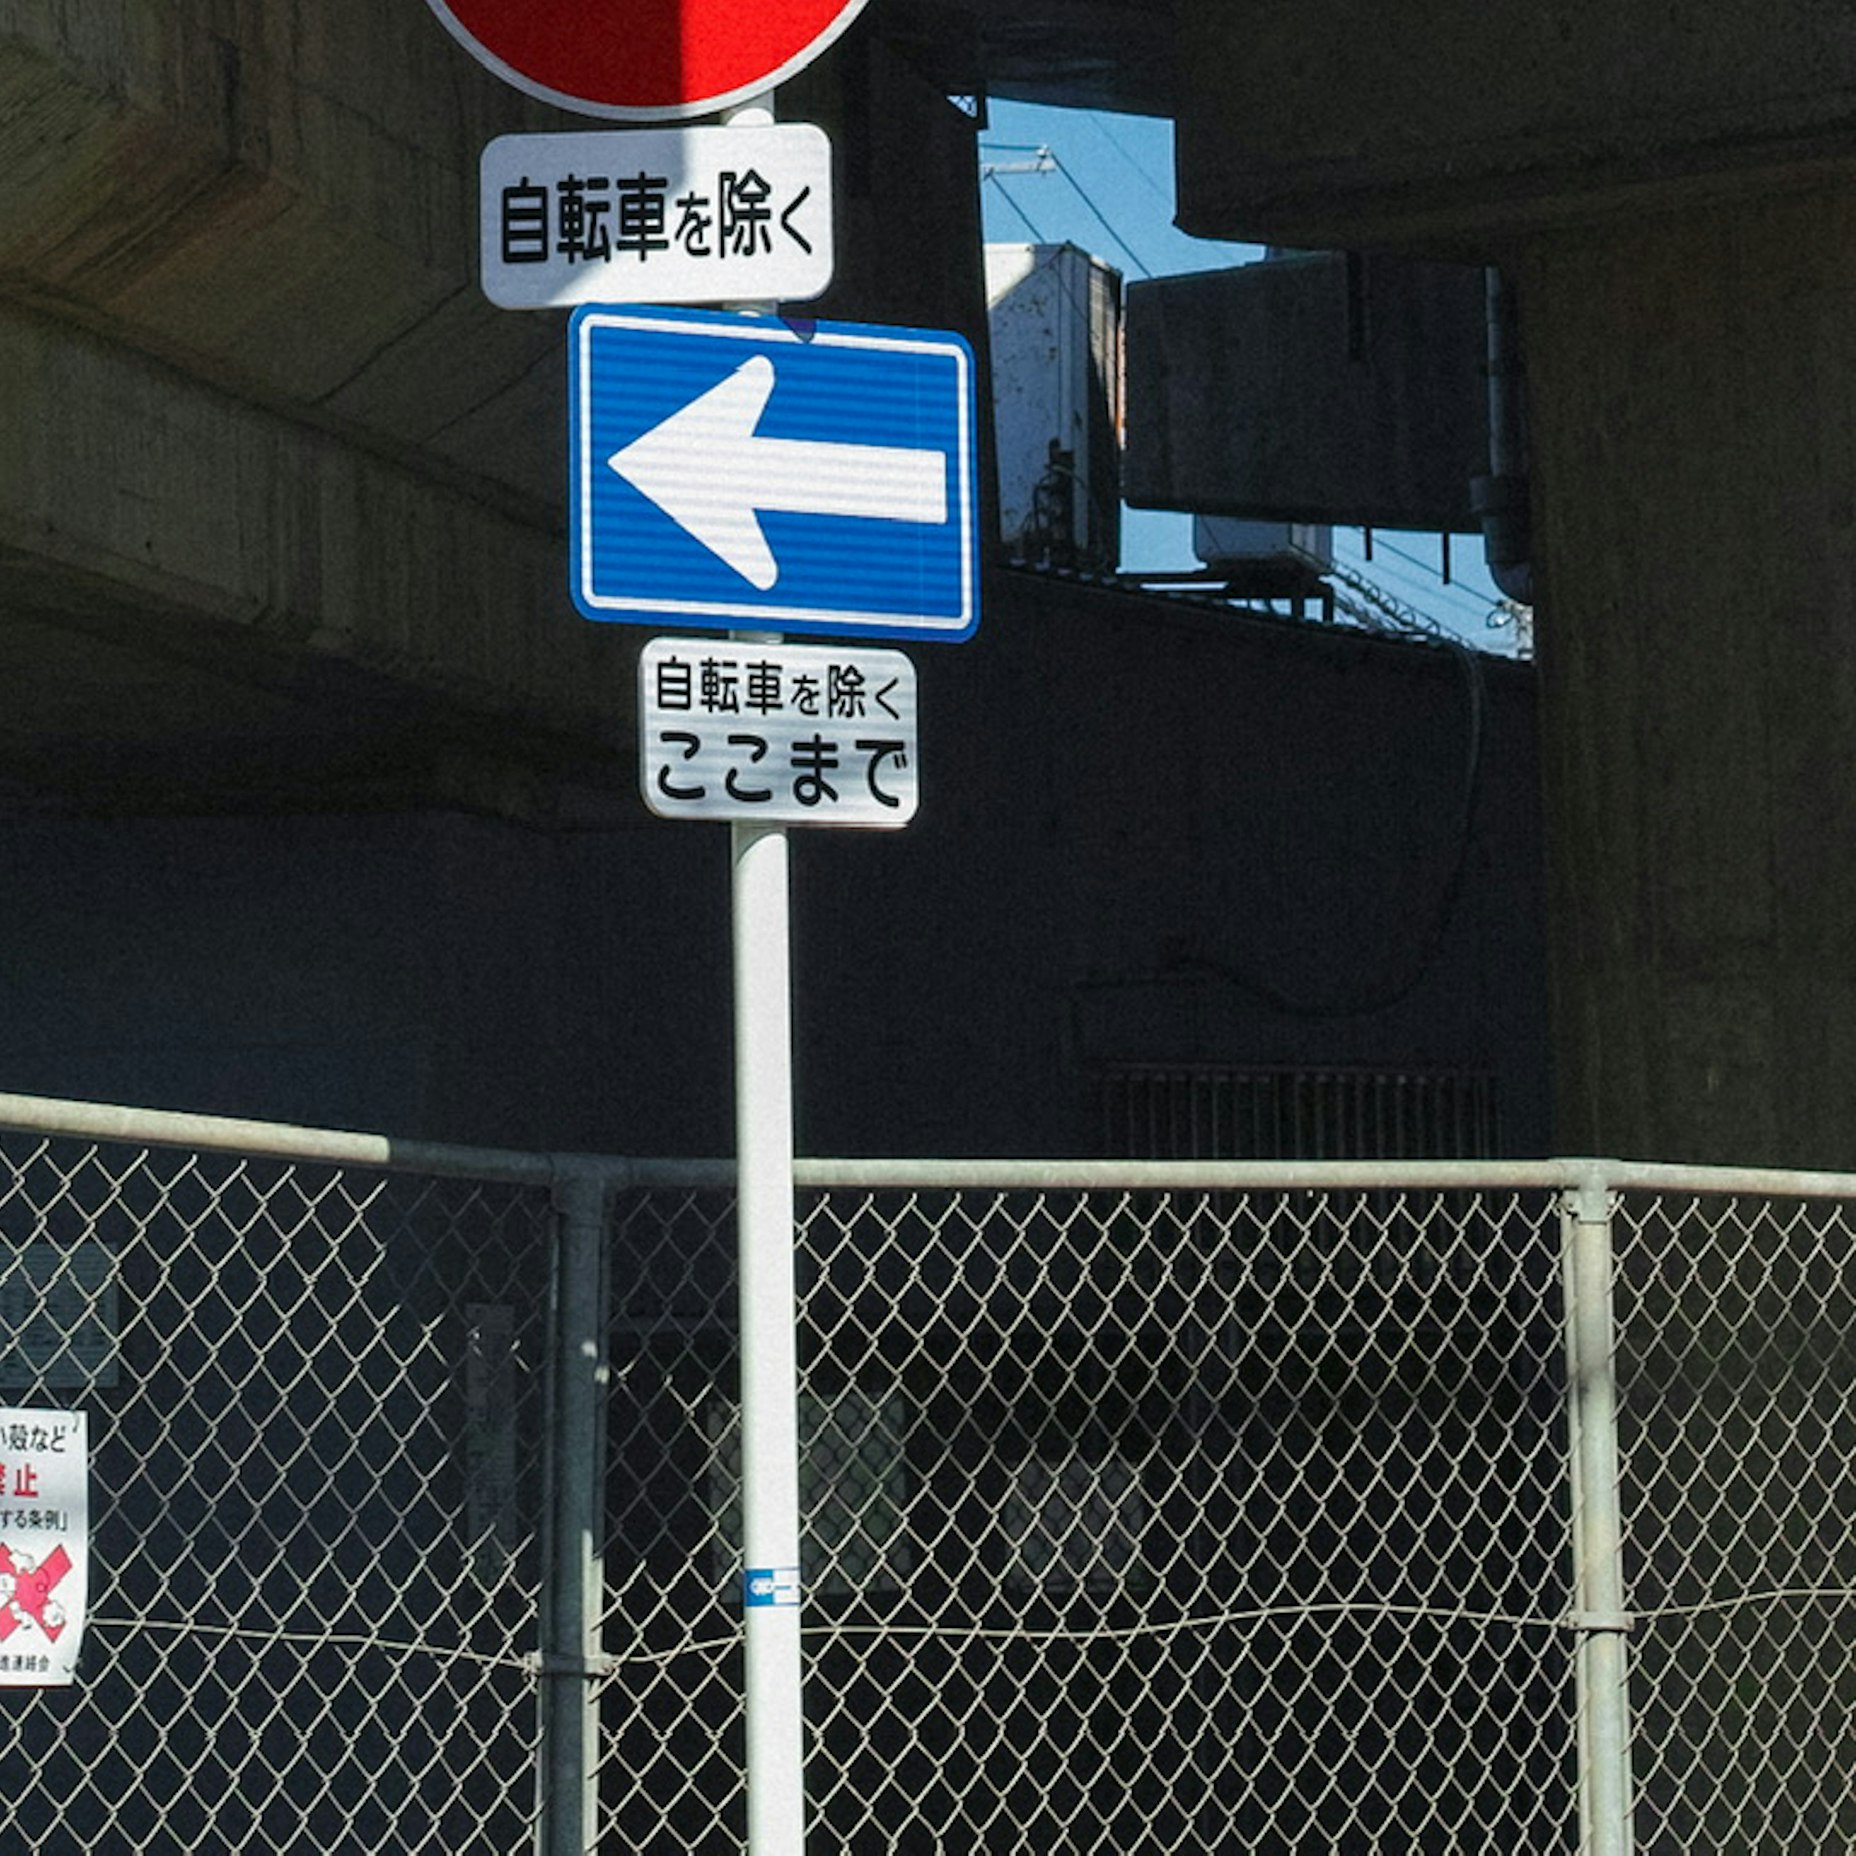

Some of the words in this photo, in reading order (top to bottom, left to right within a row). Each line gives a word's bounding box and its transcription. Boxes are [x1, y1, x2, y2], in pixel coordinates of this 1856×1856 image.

[501, 169, 814, 264] 自転車を除く
[656, 655, 902, 720] 自転車を除く
[658, 731, 909, 808] ここまで
